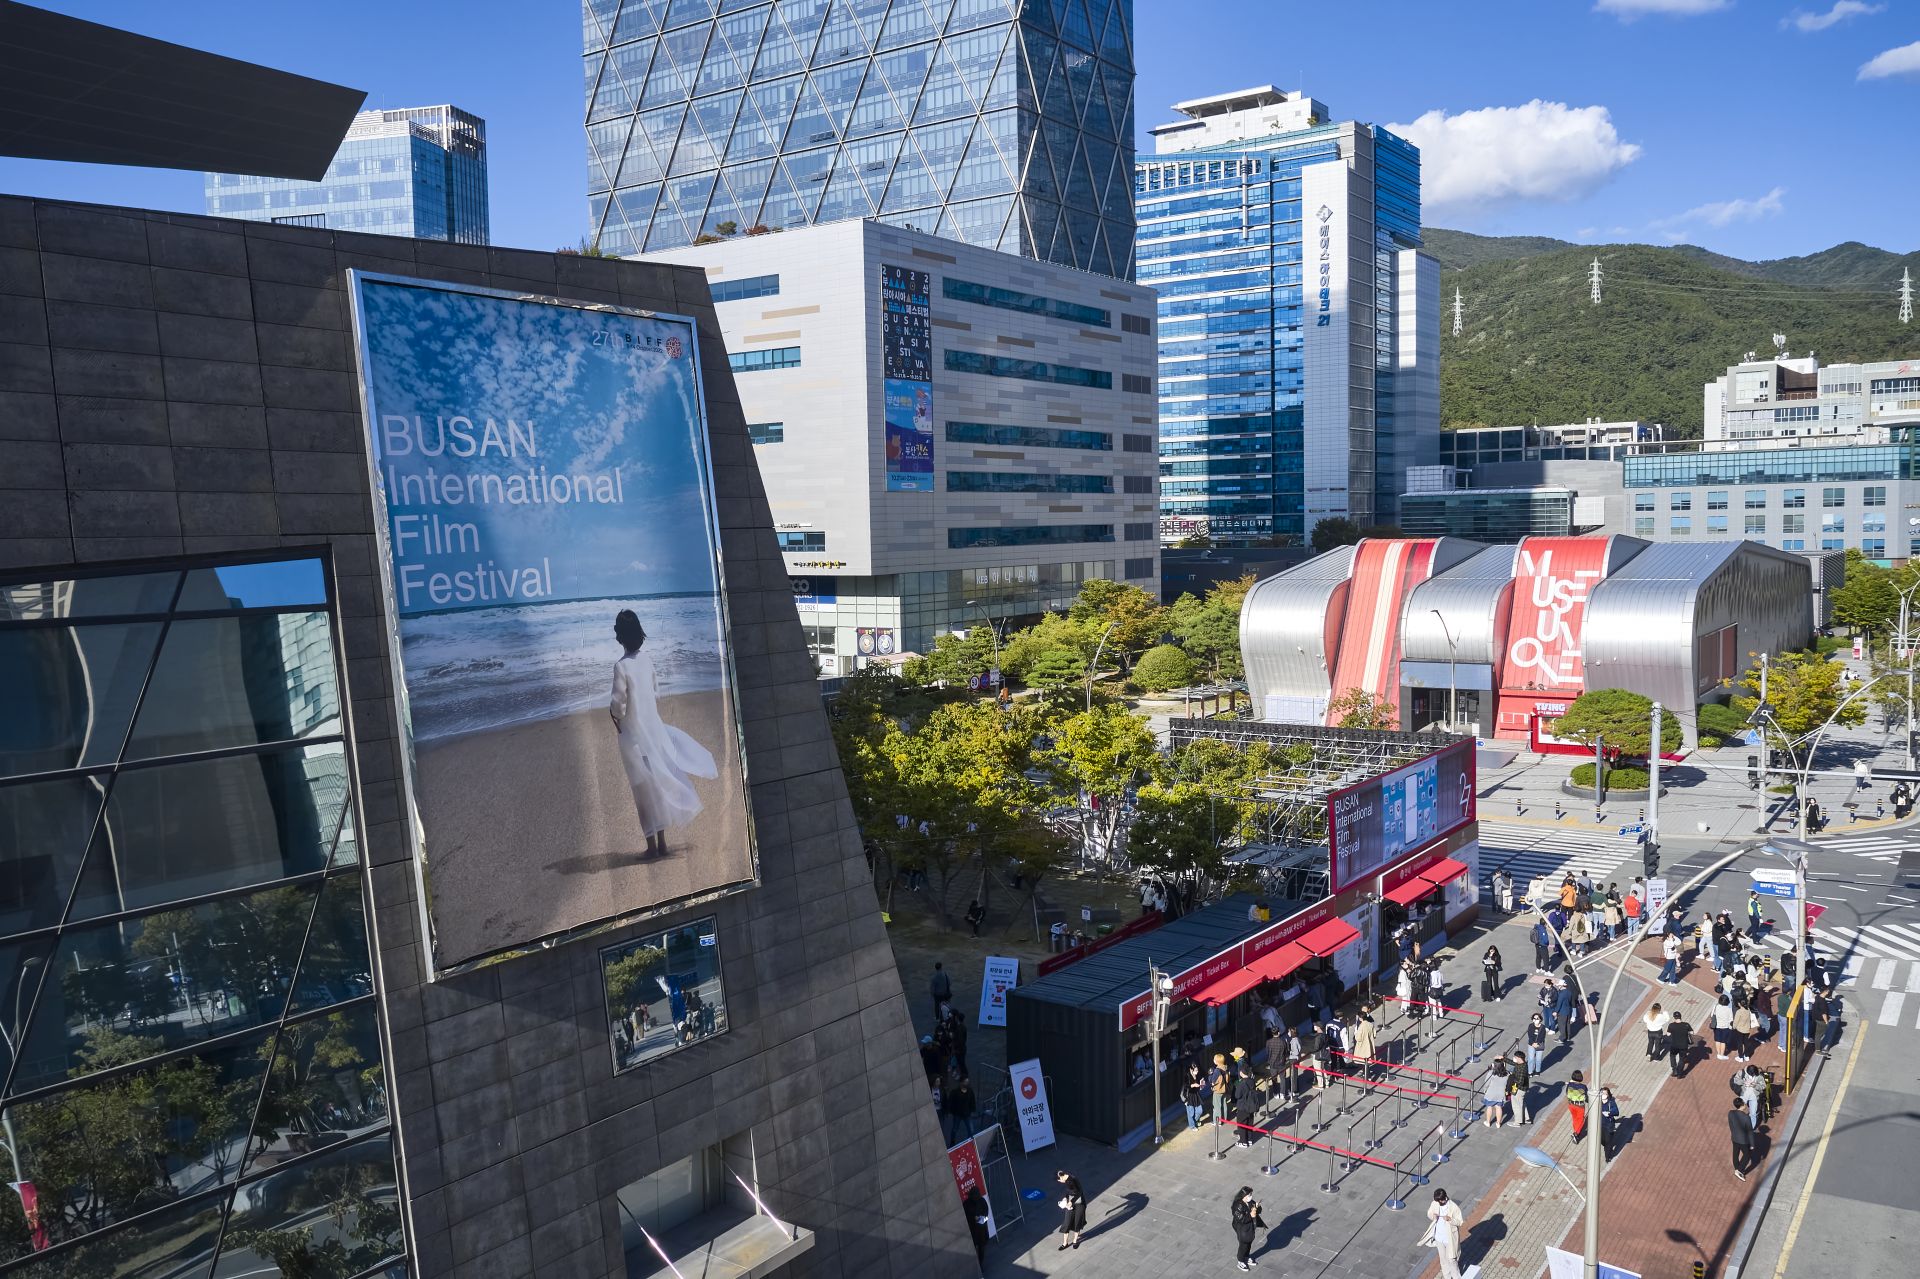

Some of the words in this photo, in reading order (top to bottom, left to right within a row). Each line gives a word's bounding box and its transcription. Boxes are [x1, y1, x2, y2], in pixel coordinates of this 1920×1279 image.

[592, 330, 624, 349] 27th
[625, 334, 662, 347] BIFF
[382, 415, 538, 459] BUSAN
[388, 466, 624, 506] International
[394, 513, 480, 557] Film
[400, 557, 552, 607] Festival
[1334, 793, 1359, 815] BUSAN
[1335, 802, 1373, 829] International
[1336, 829, 1350, 846] Film
[1337, 837, 1360, 860] Festival
[1254, 940, 1266, 951] BIFF
[1206, 965, 1220, 977] Ticket
[1220, 960, 1230, 970] Box
